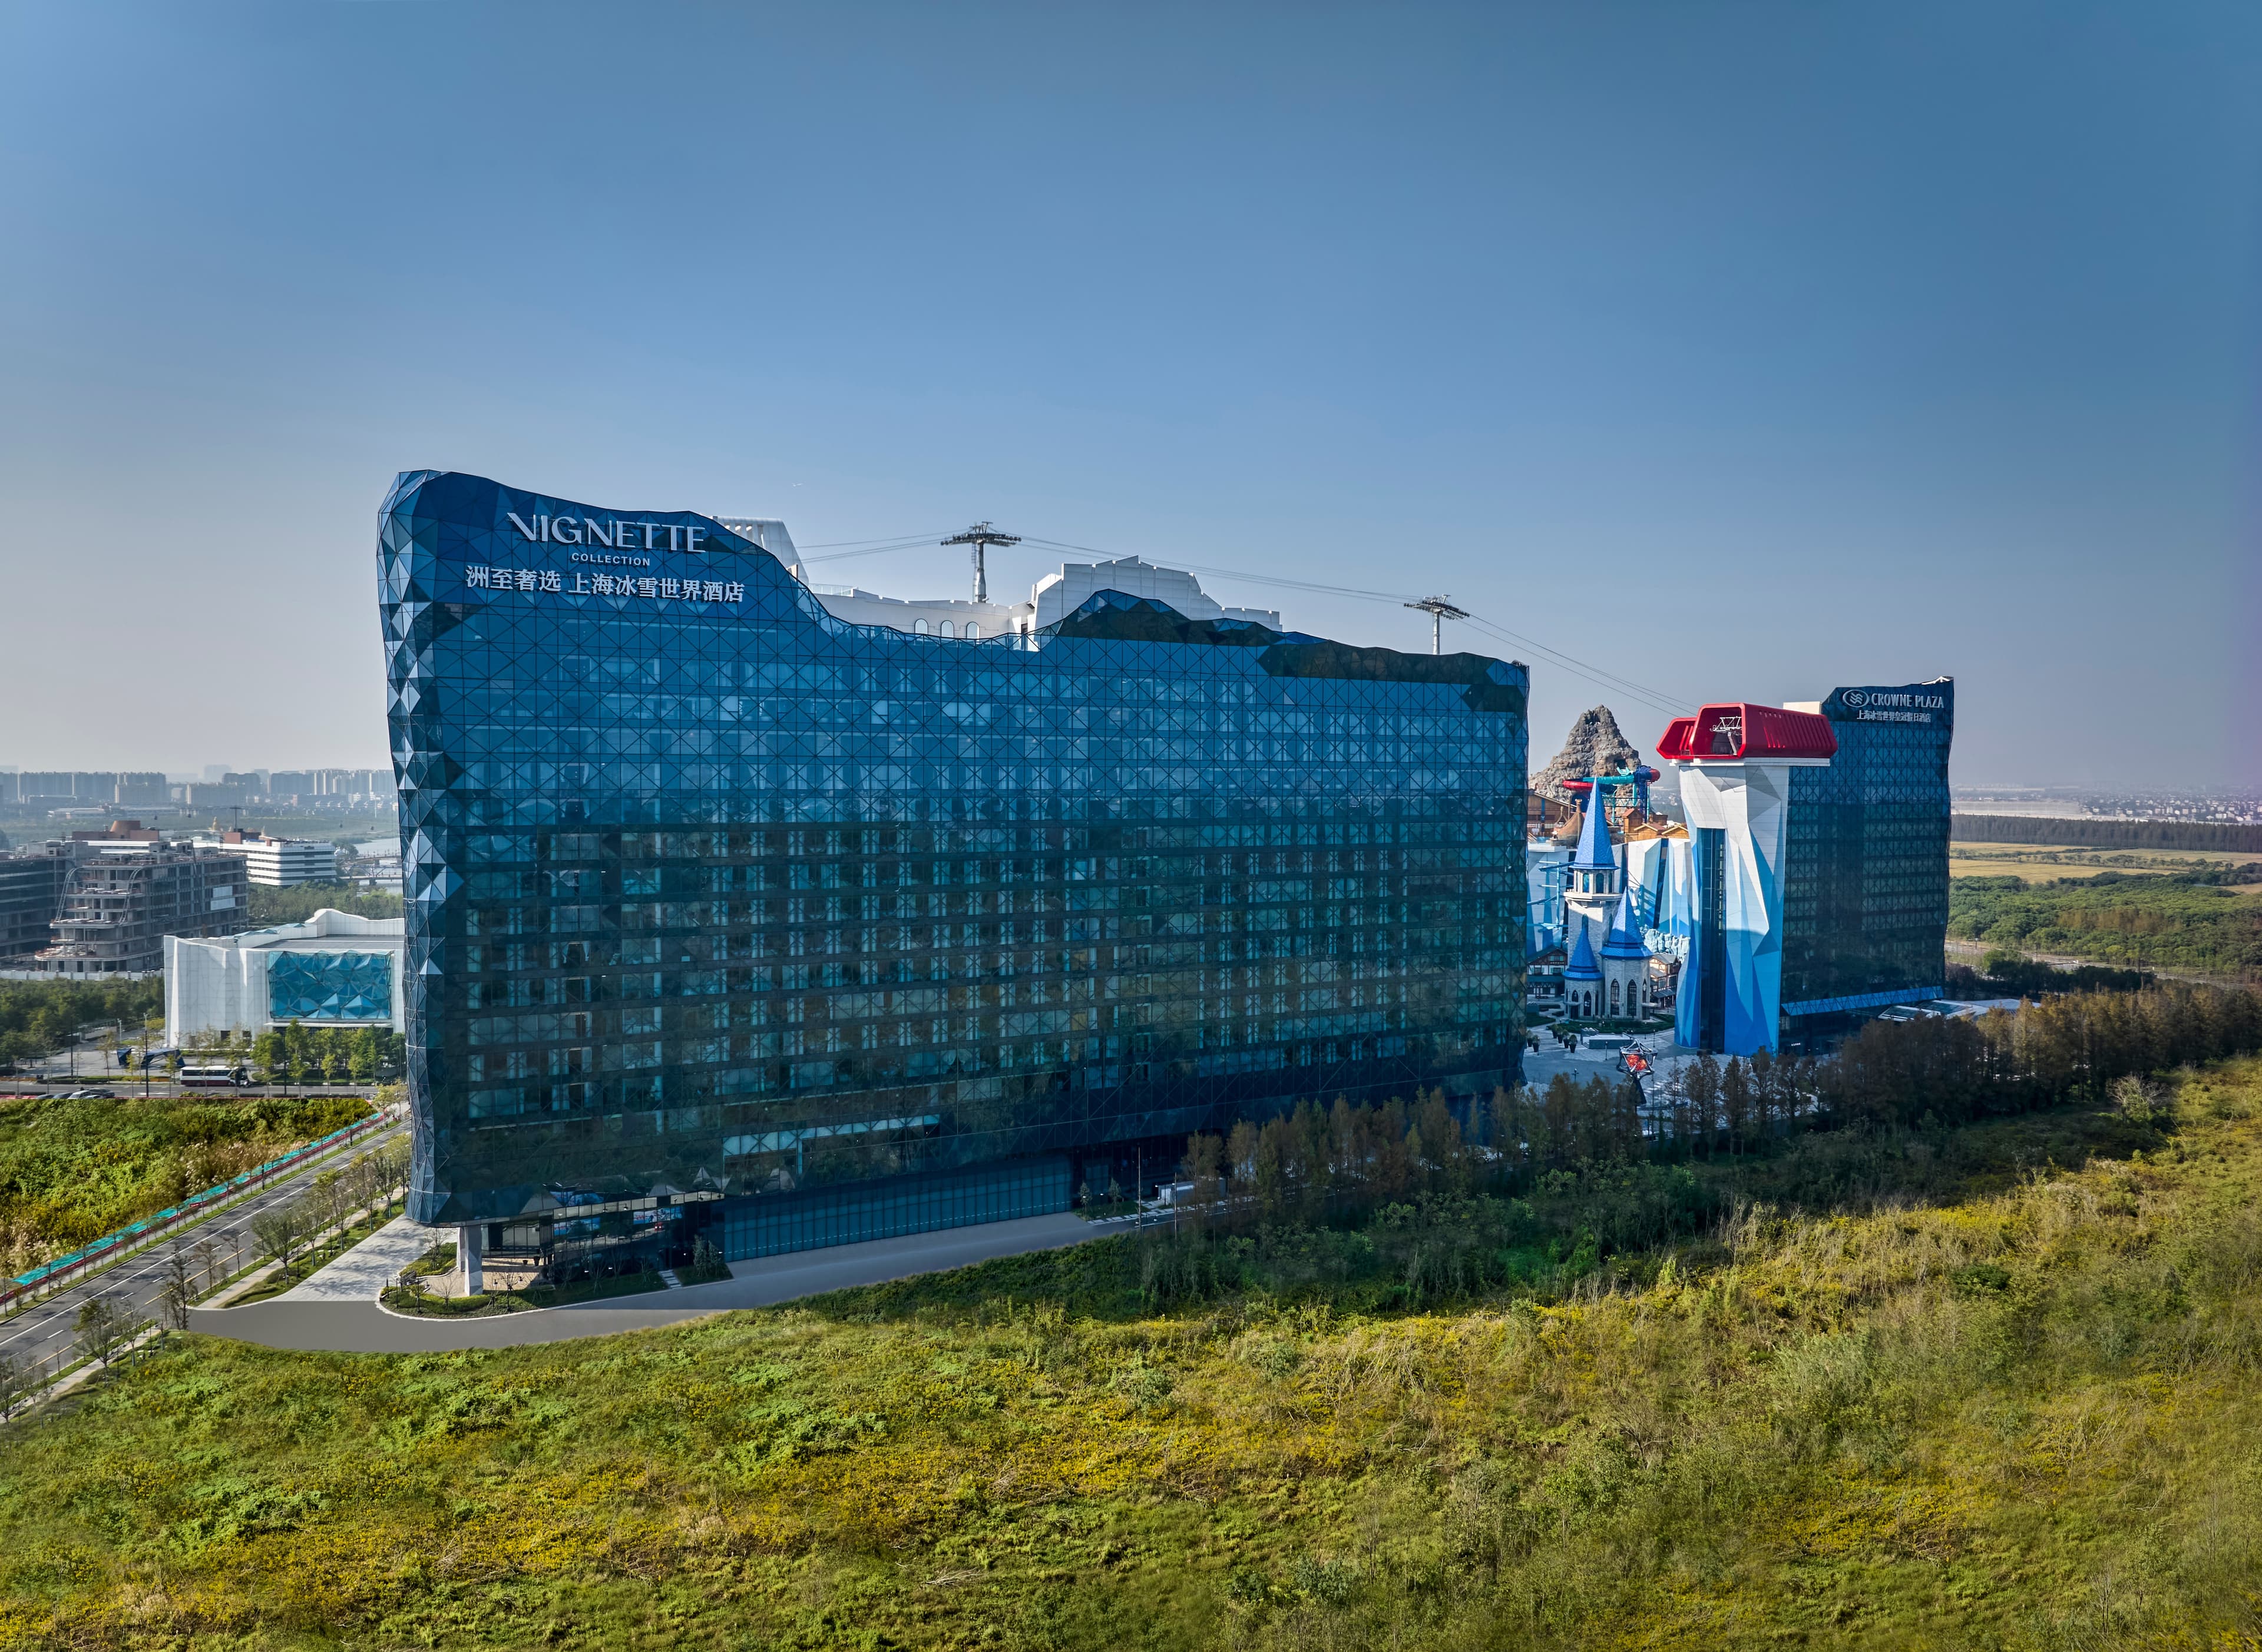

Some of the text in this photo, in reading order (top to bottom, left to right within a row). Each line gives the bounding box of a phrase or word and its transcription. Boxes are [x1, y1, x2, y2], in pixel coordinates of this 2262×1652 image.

[507, 512, 706, 552] VIGNETTE
[571, 552, 651, 566] COLLECTION
[465, 565, 745, 602] 洲至奢选 上海冰雪世界酒店
[1871, 693, 1944, 709] CROWNE PLAZA
